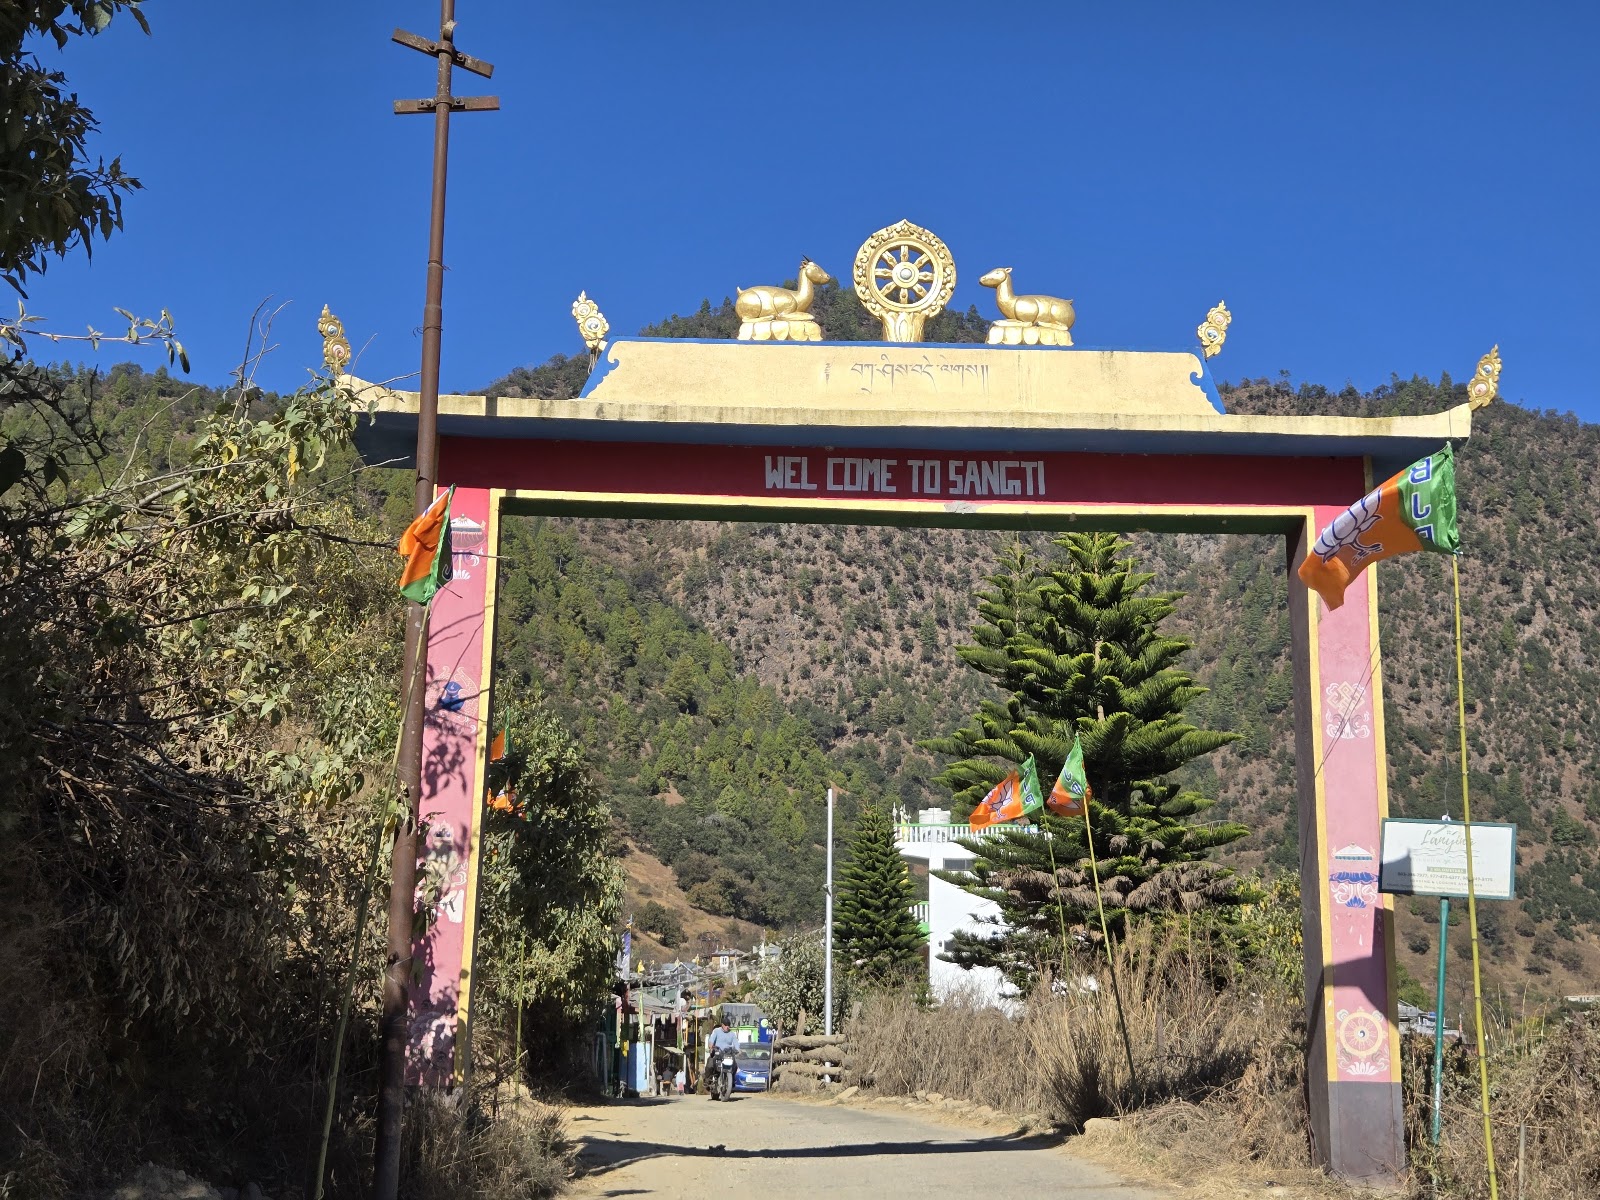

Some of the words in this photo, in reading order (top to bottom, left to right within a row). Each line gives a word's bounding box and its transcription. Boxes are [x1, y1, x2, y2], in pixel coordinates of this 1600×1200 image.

[764, 455, 817, 489] WEL
[826, 457, 897, 492] COME
[907, 459, 940, 494] TO
[949, 460, 1045, 495] SANGTI
